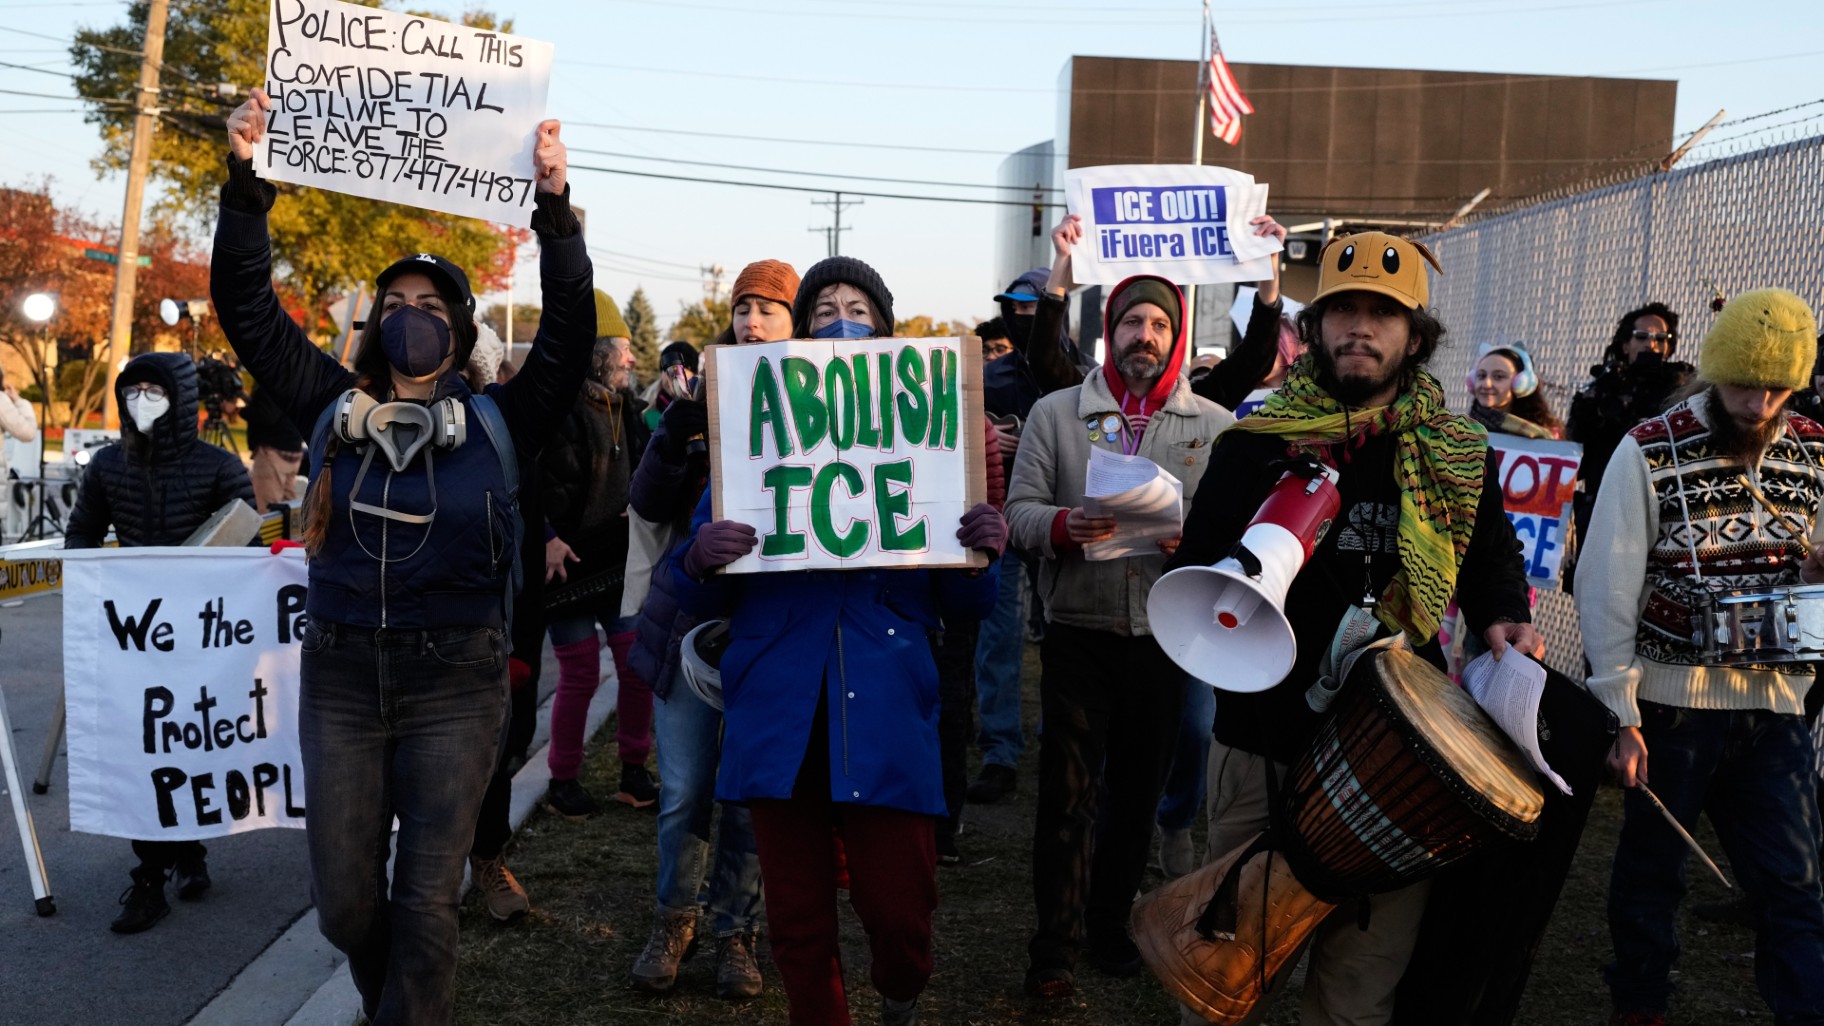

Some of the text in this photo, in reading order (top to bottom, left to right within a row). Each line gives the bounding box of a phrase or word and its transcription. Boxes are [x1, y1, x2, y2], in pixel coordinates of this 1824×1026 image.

[275, 0, 523, 68] POLICE: CALL THIS
[267, 80, 448, 138] HOTLINE TO
[267, 110, 448, 162] LEAVE THE
[1114, 190, 1218, 222] ICE OUT!
[1191, 226, 1235, 256] ICE
[749, 345, 959, 460] ABOLISH
[758, 457, 930, 560] ICE
[1494, 450, 1578, 506] OT
[1506, 512, 1559, 579] CE
[103, 598, 174, 652] We
[199, 596, 254, 649] the
[143, 678, 267, 753] Protect
[151, 762, 306, 828] PEOPL
